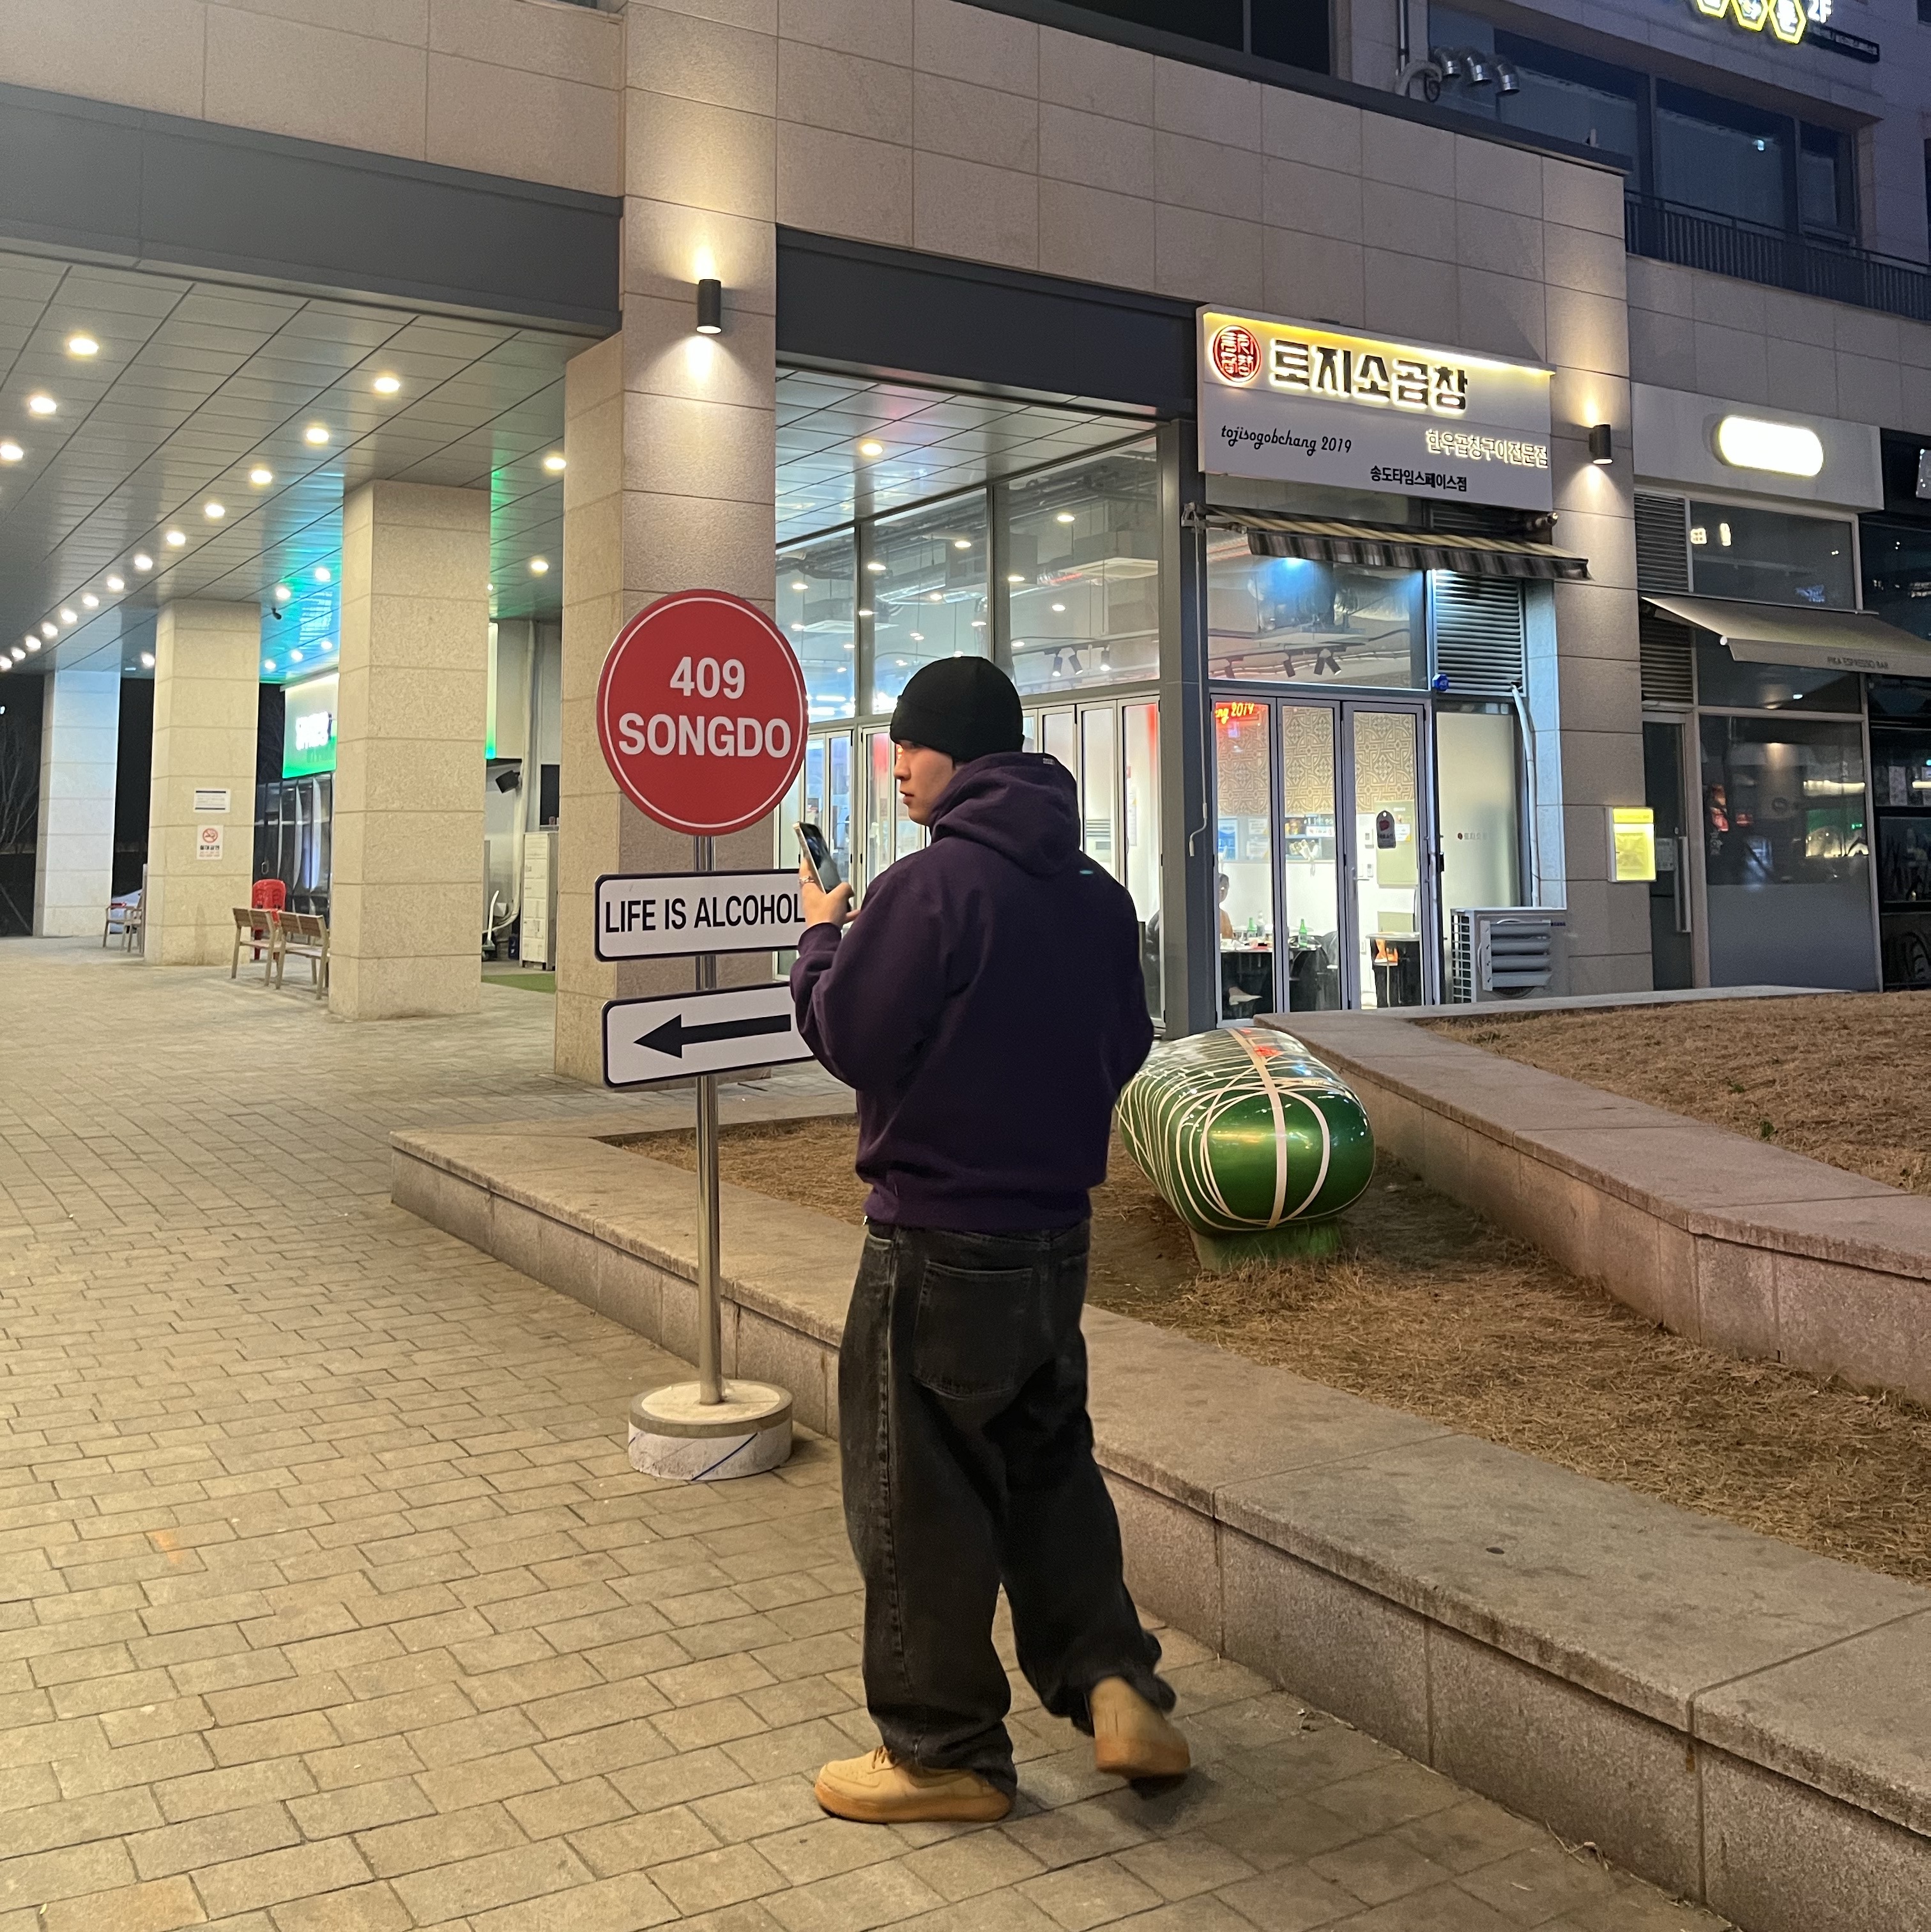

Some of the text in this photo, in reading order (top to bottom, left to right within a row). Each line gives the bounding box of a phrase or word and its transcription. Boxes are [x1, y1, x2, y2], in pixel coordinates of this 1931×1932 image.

[1273, 339, 1468, 411] 토지소곱창
[1221, 425, 1352, 456] tojisogobchang 2019
[1425, 429, 1548, 468] 한우곱창구이전문점
[1370, 465, 1467, 492] 송도타임스페이스점
[670, 656, 745, 700] 409
[618, 712, 791, 758] SONGDO
[606, 893, 806, 933] LIFE IS ALCOHOL
